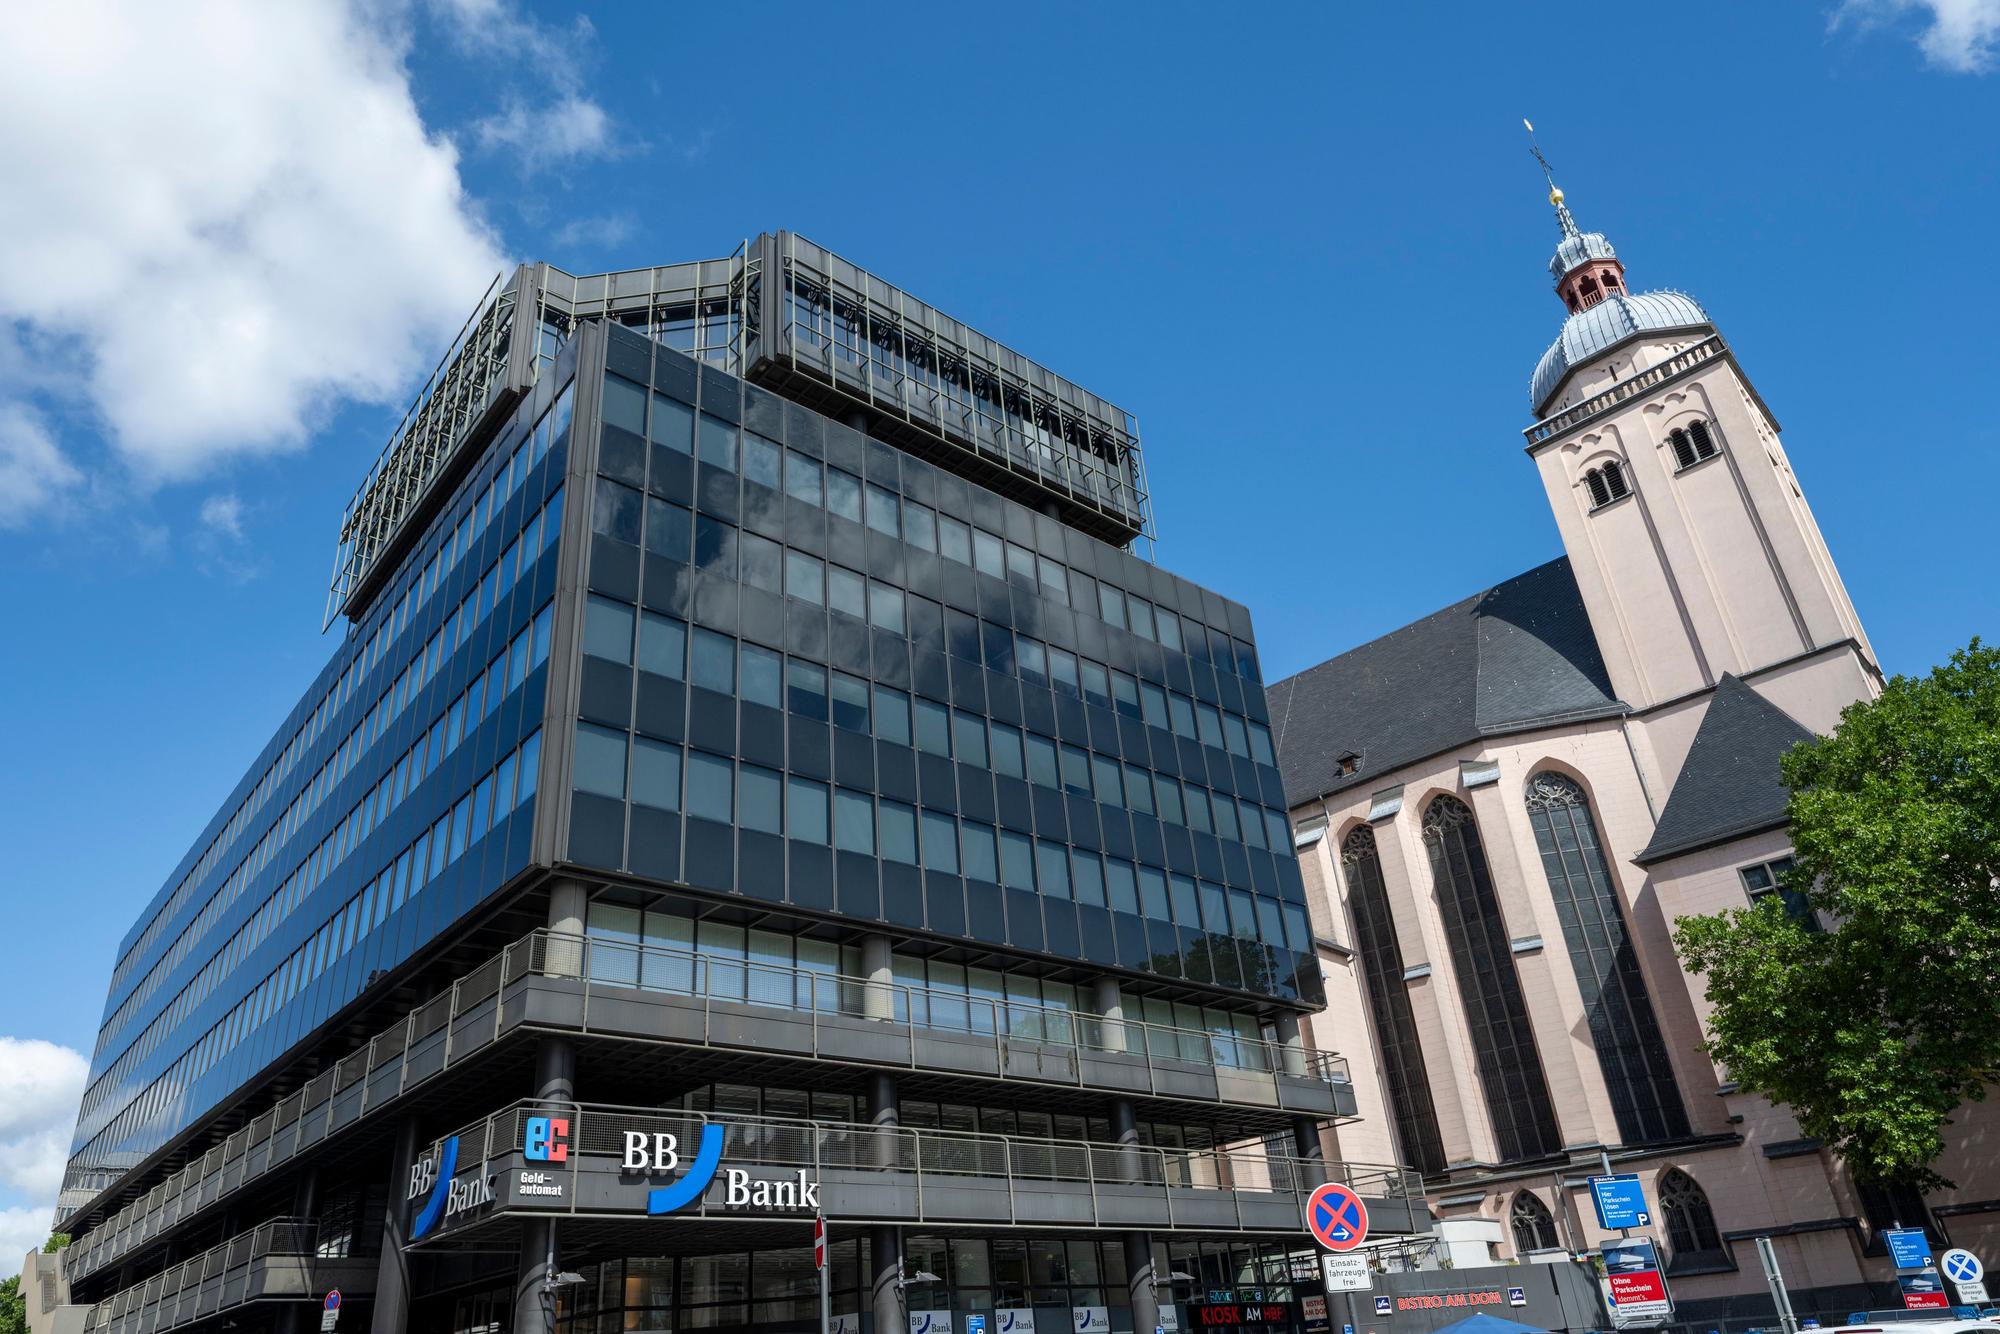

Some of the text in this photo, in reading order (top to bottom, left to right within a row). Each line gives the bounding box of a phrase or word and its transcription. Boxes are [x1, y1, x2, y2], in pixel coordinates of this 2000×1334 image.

[621, 1130, 679, 1170] BB
[407, 1158, 432, 1200] BB
[520, 1172, 552, 1184] Geld-
[445, 1161, 493, 1217] Bank
[519, 1184, 562, 1196] automat
[725, 1168, 820, 1208] Bank
[1602, 1196, 1632, 1204] Parkschein
[1637, 1213, 1648, 1226] P
[1330, 1259, 1361, 1268] Einsatz-
[1923, 1257, 1932, 1267] P
[1328, 1268, 1366, 1278] fahrzeuge
[1342, 1278, 1357, 1286] frei
[1612, 1277, 1632, 1286] Ohne
[1614, 1283, 1653, 1294] Parkschein
[1305, 1299, 1325, 1308] BISTRO
[1397, 1295, 1443, 1311] BISTRO
[1445, 1293, 1467, 1307] AM
[1469, 1291, 1502, 1306] DOM
[996, 1314, 1008, 1324] BB
[1074, 1312, 1085, 1320] BB
[1161, 1314, 1177, 1324] Bank
[1200, 1304, 1283, 1325] KIOSK AM HBF
[911, 1316, 923, 1326] BB
[1015, 1320, 1033, 1330] Bank
[1091, 1317, 1109, 1327] Bank
[931, 1322, 951, 1333] Bank
